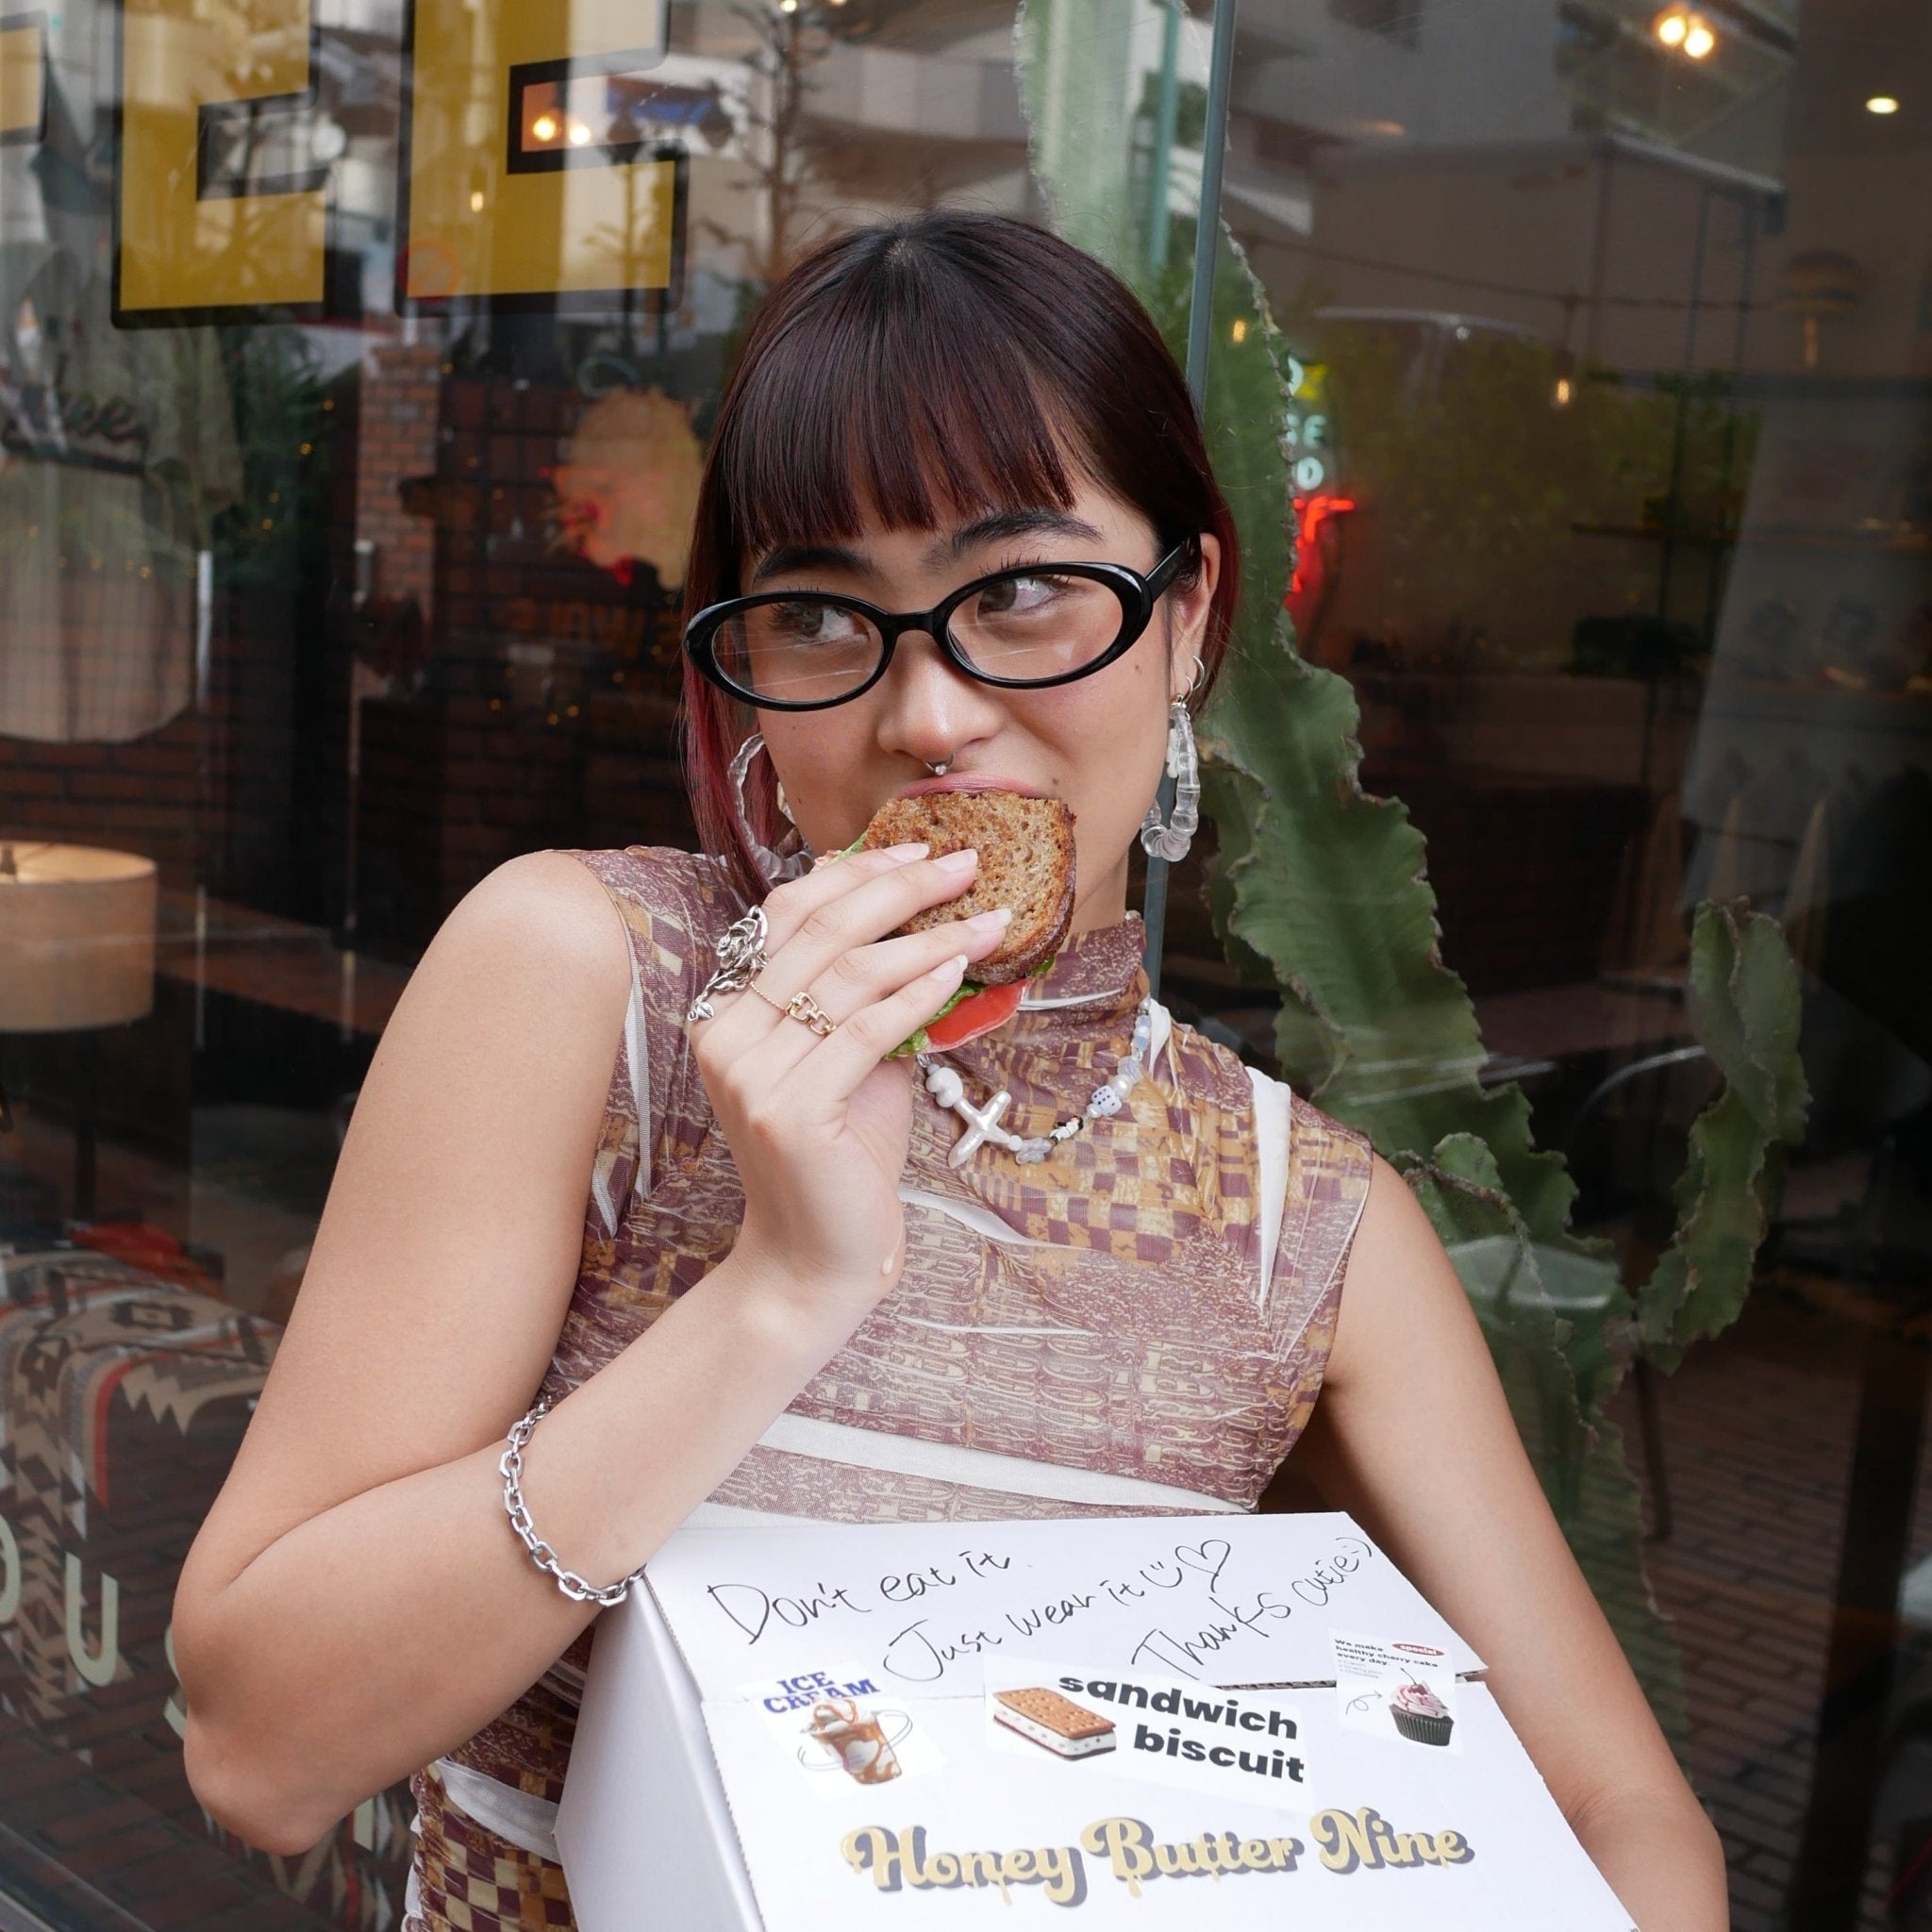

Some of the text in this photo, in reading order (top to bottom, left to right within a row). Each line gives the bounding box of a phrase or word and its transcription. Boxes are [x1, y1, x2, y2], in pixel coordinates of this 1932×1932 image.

[708, 1582, 872, 1644] Don't
[880, 1567, 956, 1601] eat
[884, 1619, 1002, 1681] Just
[1100, 1579, 1145, 1606] it
[1132, 1591, 1291, 1679] Thanks
[1335, 1639, 1383, 1652] We make
[1369, 1657, 1388, 1666] day
[776, 1671, 835, 1694] ICE
[1058, 1677, 1297, 1740] sandwich
[1134, 1724, 1305, 1783] biscuit
[840, 1806, 1475, 1907] Honey Butter Nine
